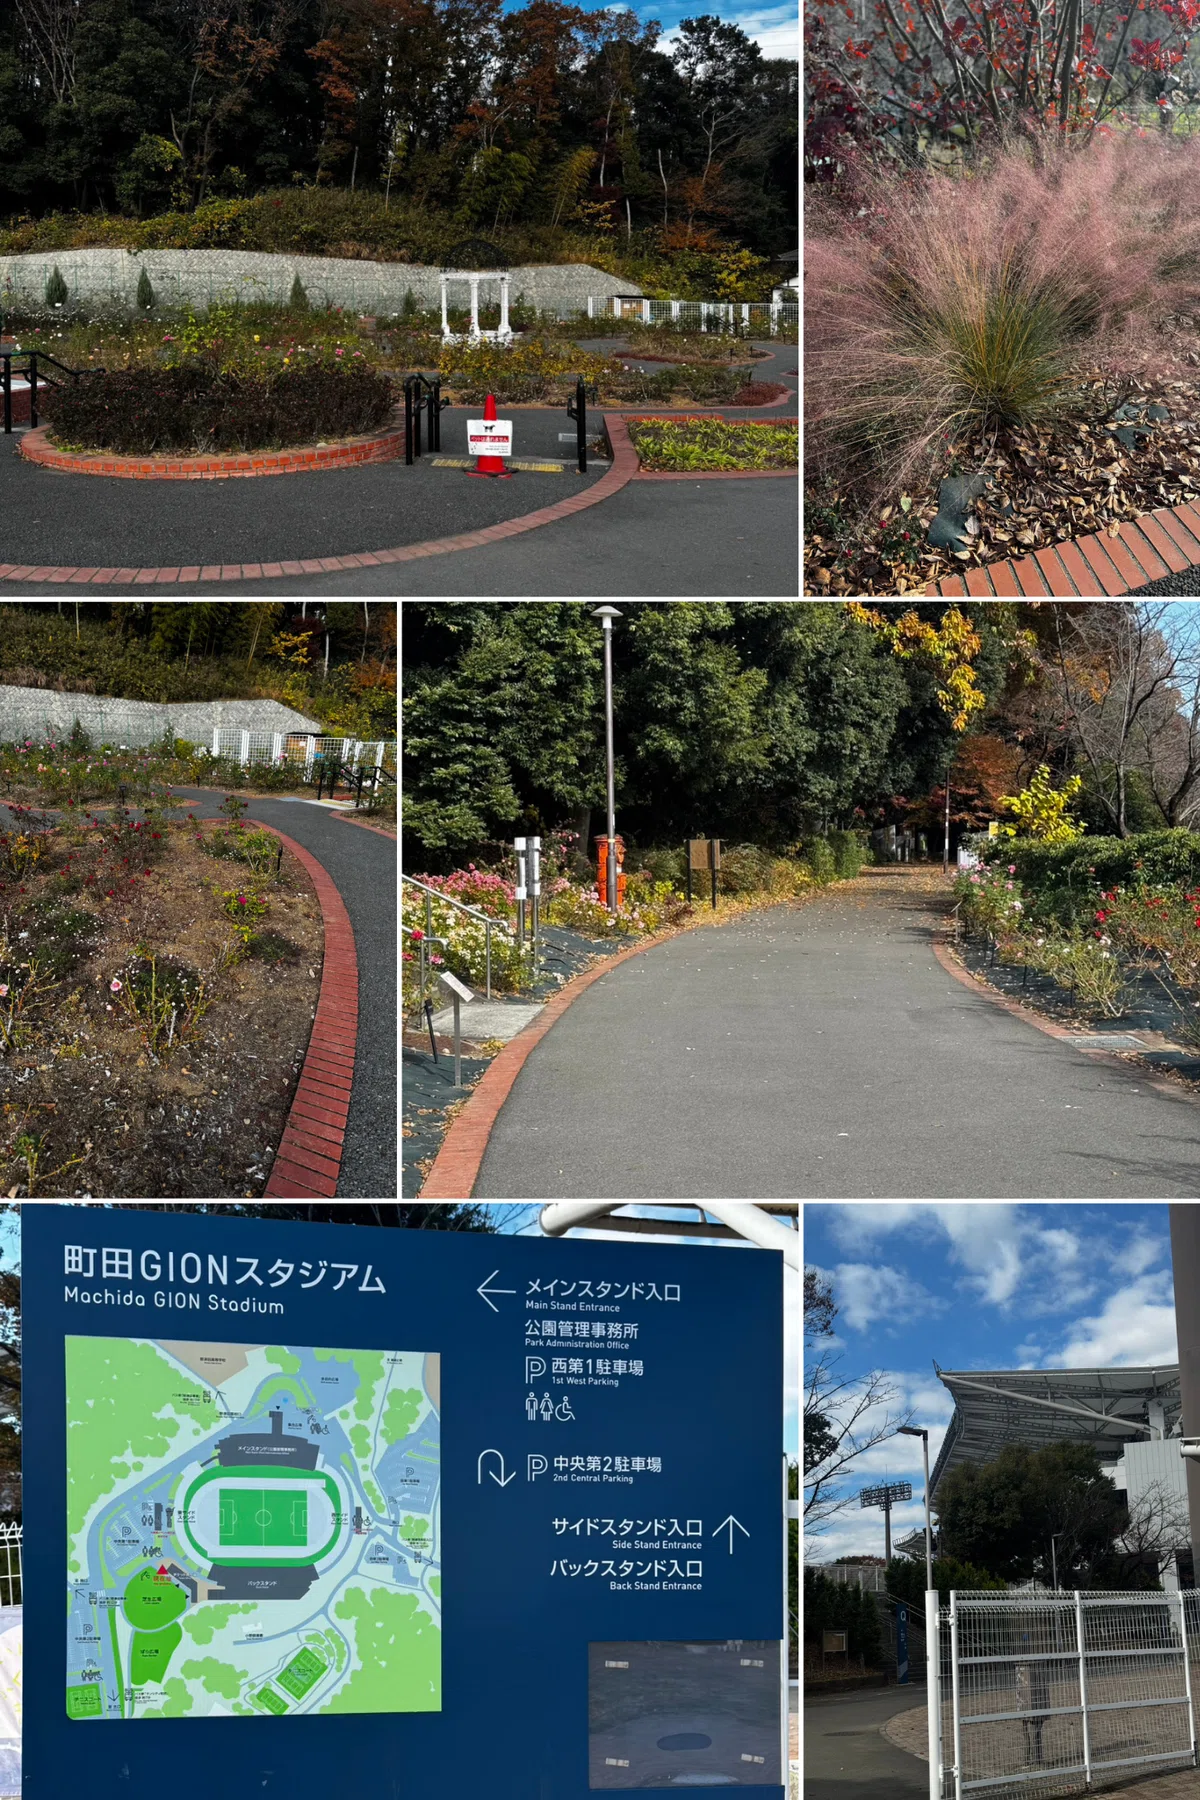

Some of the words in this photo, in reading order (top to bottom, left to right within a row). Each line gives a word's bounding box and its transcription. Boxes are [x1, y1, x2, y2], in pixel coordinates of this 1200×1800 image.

[64, 1244, 386, 1294] 町田GIONスタジアム
[64, 1285, 146, 1307] Machida
[154, 1290, 200, 1310] GION
[208, 1294, 284, 1314] Stadium
[525, 1278, 681, 1302] メインスタンド入口
[525, 1299, 548, 1310] Main
[550, 1300, 577, 1311] Stand
[579, 1301, 620, 1312] Entrance
[525, 1319, 639, 1340] 公園管理事務所
[525, 1337, 544, 1347] Park
[546, 1339, 605, 1349] Administration
[606, 1341, 630, 1350] Office
[551, 1357, 644, 1377] 西第1駐車場
[552, 1376, 564, 1385] 1st
[566, 1377, 586, 1385] West
[588, 1377, 619, 1388] Parking
[553, 1454, 662, 1473] 中央第2駐車場
[553, 1473, 568, 1482] 2nd
[570, 1473, 601, 1482] Central
[603, 1474, 634, 1485] Parking
[551, 1517, 703, 1537] サイドスタンド入口
[612, 1540, 632, 1549] Side
[634, 1540, 660, 1549] Stand
[662, 1540, 702, 1550] Entrance
[550, 1558, 703, 1578] バックスタンド入口
[609, 1581, 633, 1590] Back
[634, 1581, 660, 1590] Stand
[662, 1581, 702, 1590] Entrance
